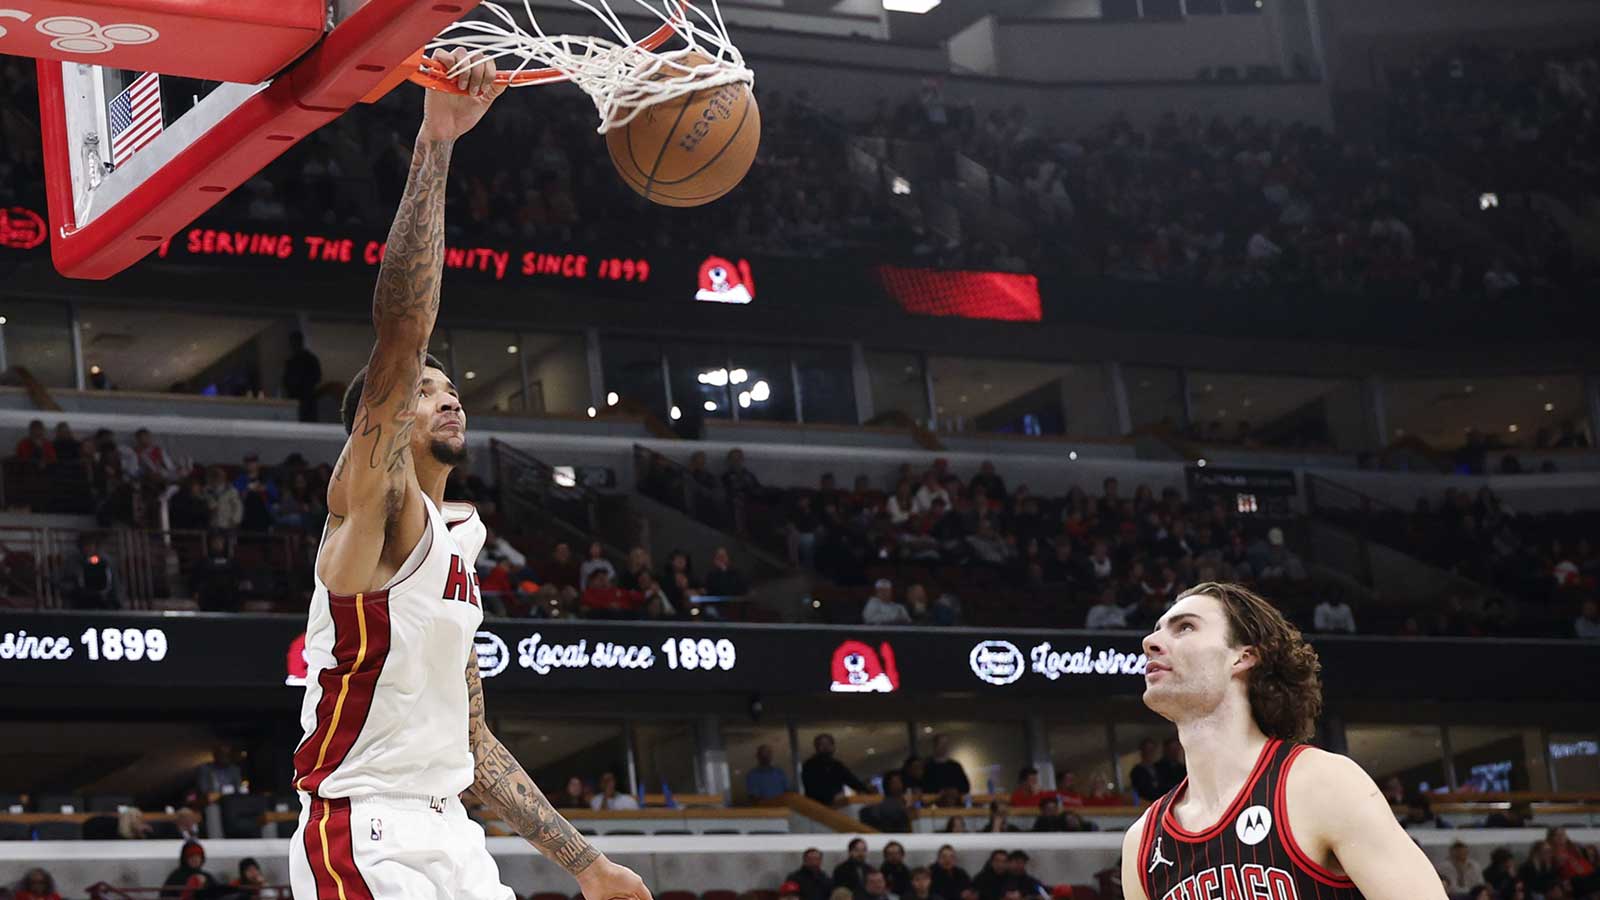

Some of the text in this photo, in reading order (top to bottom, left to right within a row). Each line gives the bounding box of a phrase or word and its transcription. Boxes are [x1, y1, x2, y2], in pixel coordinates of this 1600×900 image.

[188, 229, 293, 258] SERVING
[304, 236, 353, 263] THE
[521, 251, 588, 278] SINCE
[598, 257, 651, 283] 1899
[0, 628, 168, 661] since 1899
[518, 632, 589, 675] Local
[591, 642, 656, 670] since
[661, 637, 737, 671] 1899
[1031, 641, 1095, 680] Local
[1094, 647, 1147, 675] since
